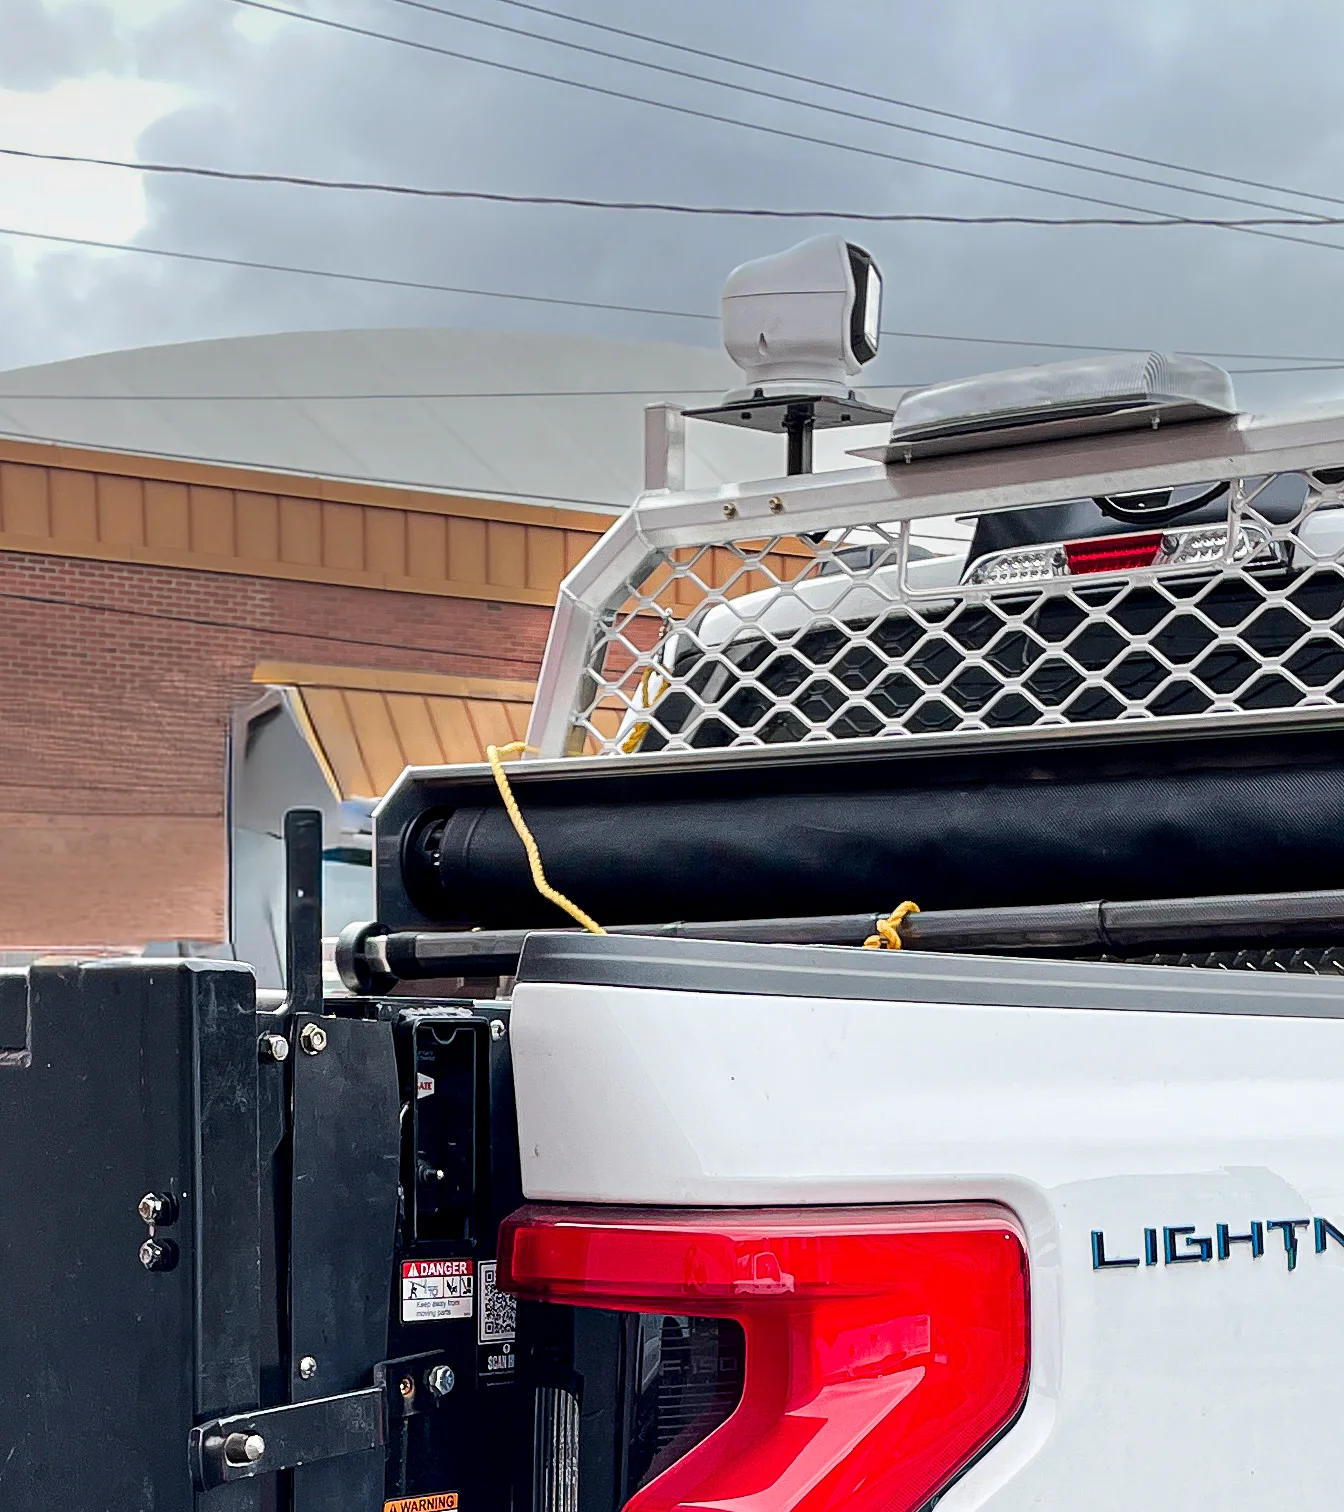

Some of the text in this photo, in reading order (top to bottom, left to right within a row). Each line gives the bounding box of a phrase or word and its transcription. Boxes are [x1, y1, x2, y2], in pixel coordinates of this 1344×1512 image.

[420, 1261, 467, 1276] DANGER
[416, 1309, 451, 1318] moving parts
